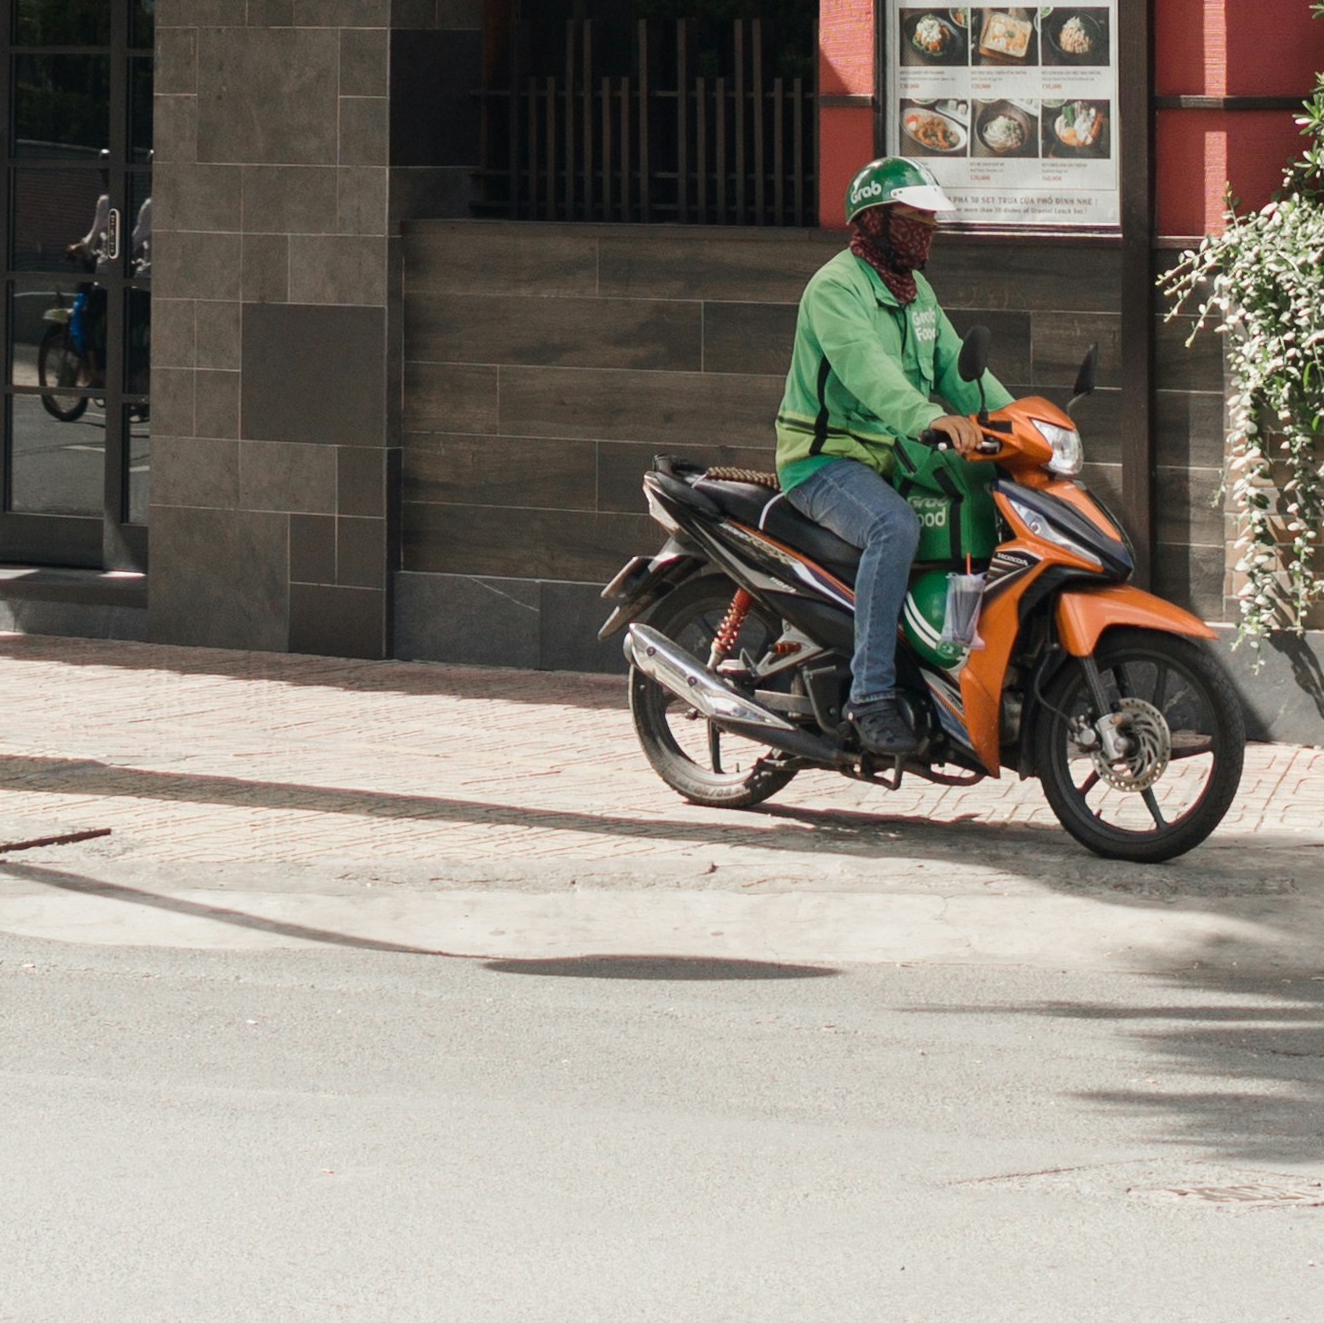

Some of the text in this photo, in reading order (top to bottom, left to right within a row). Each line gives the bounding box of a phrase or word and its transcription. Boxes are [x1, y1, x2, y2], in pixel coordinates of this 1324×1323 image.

[850, 180, 882, 204] Grab
[981, 196, 995, 204] SET
[997, 552, 1029, 566] HONDA
